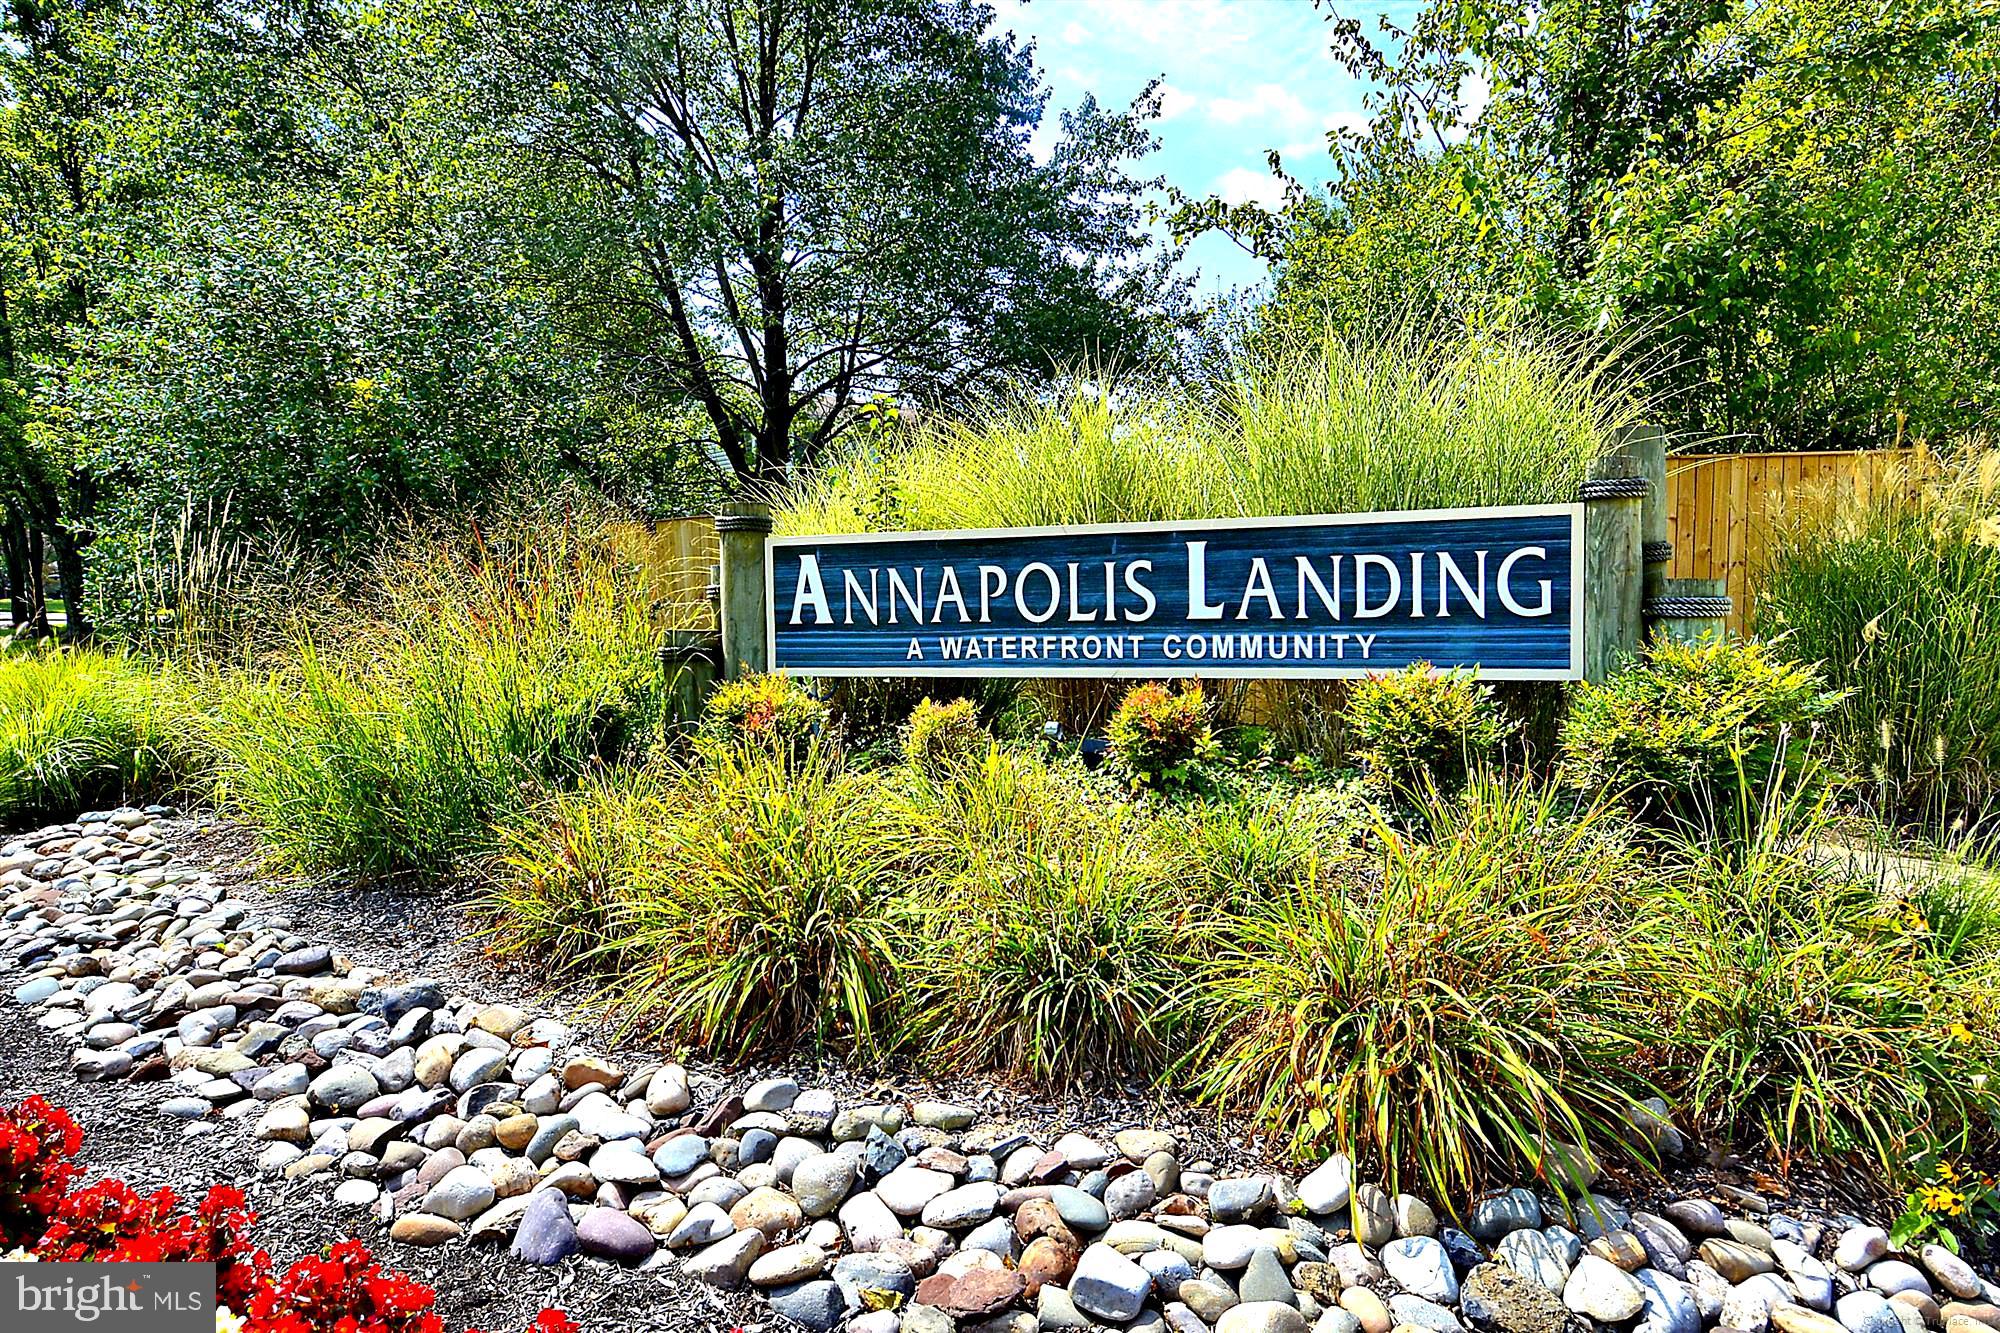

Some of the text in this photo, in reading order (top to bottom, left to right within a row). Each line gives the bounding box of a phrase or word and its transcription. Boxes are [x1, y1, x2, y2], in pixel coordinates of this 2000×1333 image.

[789, 540, 1552, 626] ANNAPOLIS LANDING
[906, 633, 1377, 660] A WATERFRONT COMMUNITY
